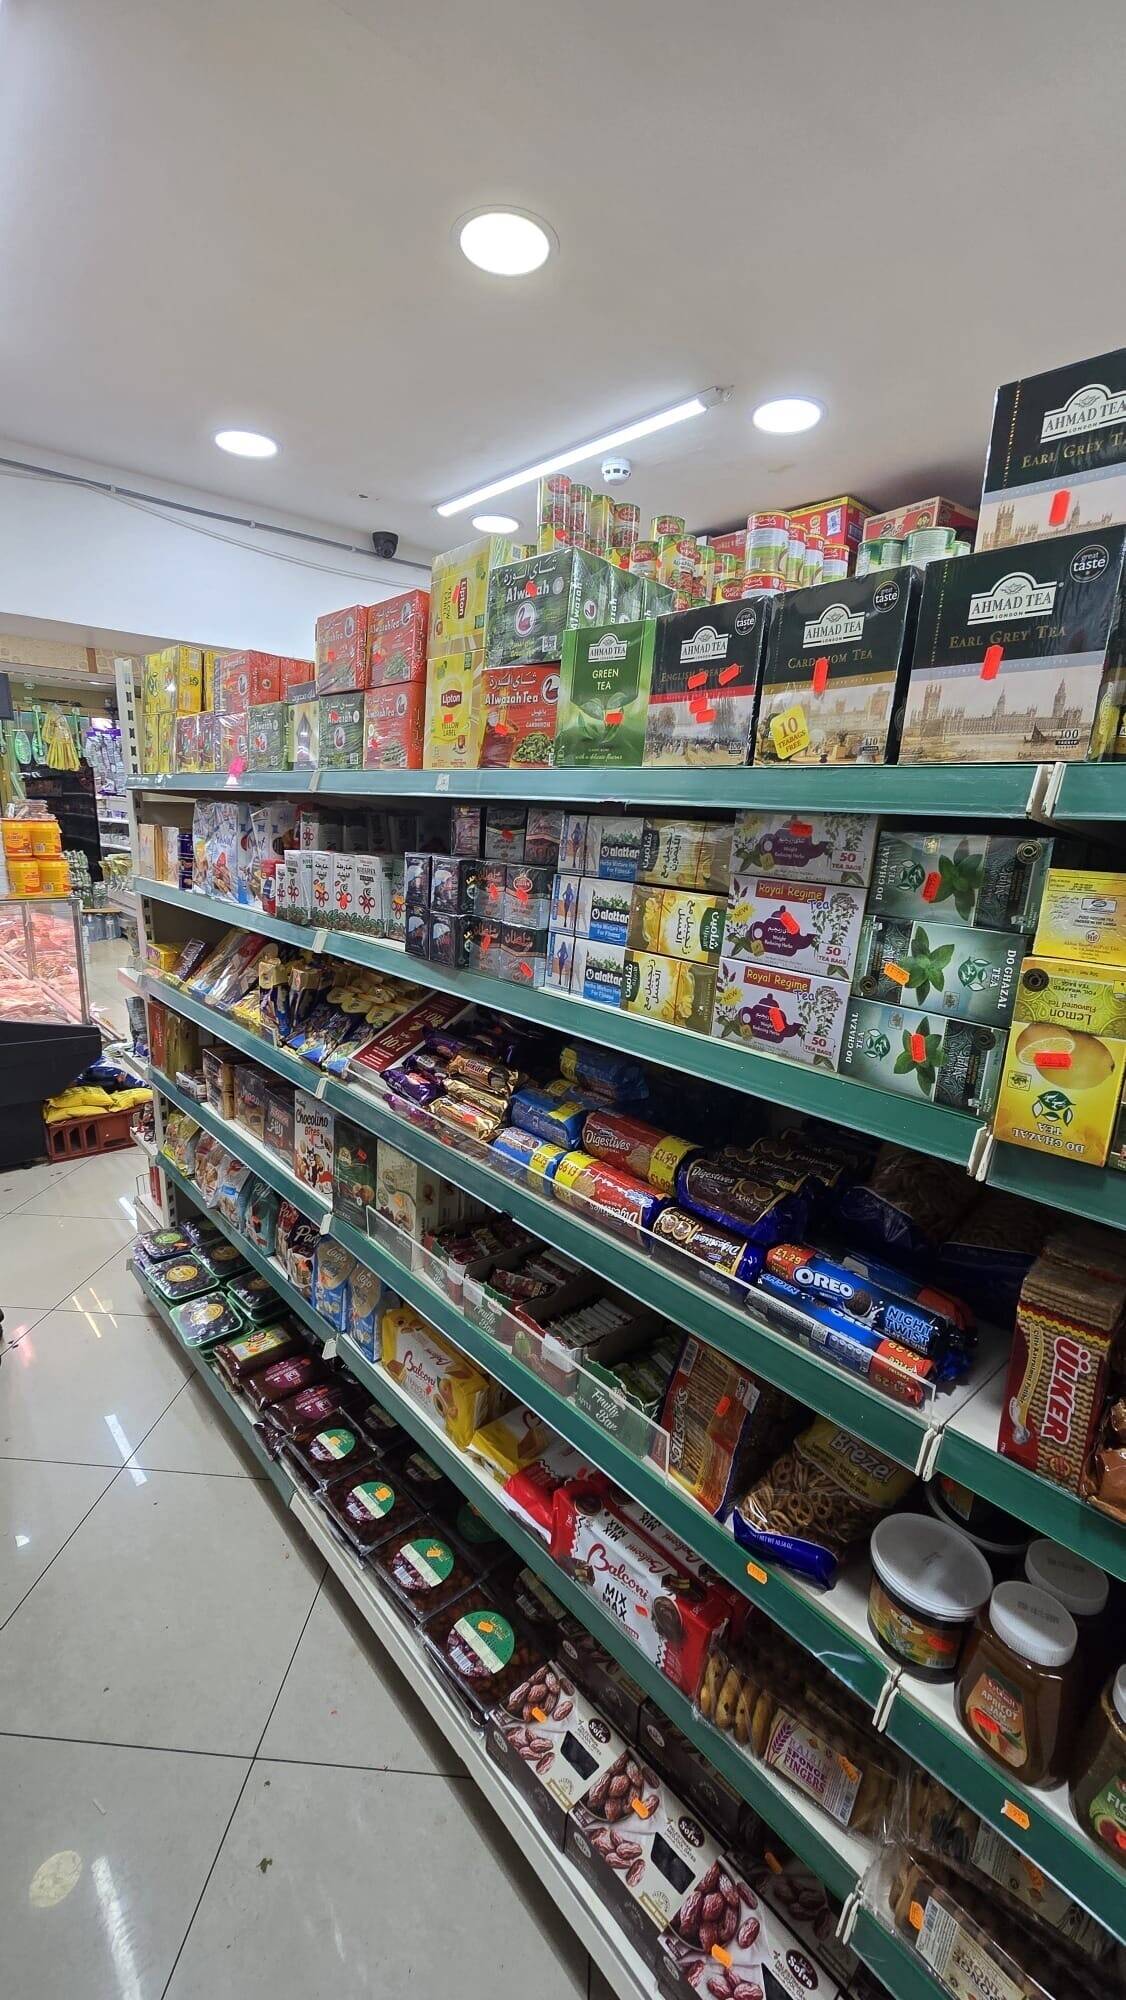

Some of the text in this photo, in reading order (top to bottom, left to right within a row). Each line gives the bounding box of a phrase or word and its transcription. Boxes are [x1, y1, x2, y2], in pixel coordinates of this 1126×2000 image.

[1044, 408, 1097, 432] AHMAD
[1068, 422, 1098, 433] LONDON
[1021, 440, 1104, 469] EARL GREY
[1072, 556, 1106, 573] taste
[458, 580, 466, 617] Lipton
[506, 580, 550, 602] Alwaah
[874, 592, 898, 604] taste
[972, 592, 1052, 616] AHMAD TEA
[994, 610, 1024, 620] LONDON
[805, 621, 862, 640] AHMAD TEA
[950, 624, 1067, 649] EARL GREY TEA
[589, 646, 626, 658] AHMAD TEA
[682, 638, 726, 656] AHMAD TEA
[788, 649, 873, 668] CARDOM TEA
[592, 668, 619, 678] GREEN
[597, 682, 612, 691] TEA
[442, 694, 462, 706] Lipton
[484, 691, 539, 706] Alwazah Tea
[779, 716, 798, 739] 10
[1059, 728, 1079, 740] 100
[778, 728, 806, 749] TEABAGS
[785, 741, 802, 753] FREE
[864, 737, 879, 747] 110
[840, 853, 856, 862] 50
[876, 845, 891, 900] DO GHAZAL
[887, 864, 897, 884] TEA
[760, 884, 822, 901] Royal Regime
[808, 899, 830, 910] Tea
[600, 910, 630, 924] alattar
[826, 946, 842, 956] 50
[830, 957, 847, 965] BAGS
[746, 969, 808, 991] Royal Regime
[990, 968, 1001, 988] TEA
[997, 950, 1017, 1010] DO GHAZAL
[724, 990, 738, 1000] NEW
[793, 989, 815, 1000] Tea
[1048, 1000, 1097, 1013] Flavoured Tea
[1048, 1008, 1092, 1026] Lemon
[811, 1036, 826, 1047] 50
[846, 1012, 859, 1064] DO GHAZAL
[856, 1030, 866, 1048] TEA
[805, 1044, 832, 1056] TEA BAGS
[296, 1108, 329, 1128] Chocolino
[304, 1126, 320, 1137] Bites
[1036, 1122, 1062, 1136] TEA
[586, 1131, 632, 1150] Digestives
[1012, 1128, 1086, 1154] DO GHAZAL
[653, 1150, 678, 1164] £1.99
[692, 1167, 736, 1184] Digestives
[694, 1232, 740, 1256] Digestives
[326, 1248, 346, 1264] Lago
[774, 1247, 802, 1264] £1.29
[357, 1271, 372, 1288] Lago
[795, 1266, 855, 1298] OREO
[478, 1318, 496, 1336] Bar
[887, 1305, 934, 1334] NIGHT
[884, 1317, 930, 1346] TWIST
[404, 1350, 436, 1386] Balconi
[1041, 1336, 1092, 1446] ÜLKER
[592, 1390, 620, 1418] Fruity
[596, 1408, 618, 1432] Bar
[829, 1430, 896, 1482] Brezel
[602, 1527, 624, 1542] MIX
[608, 1518, 628, 1538] MAX
[625, 1542, 668, 1574] Balconi
[587, 1543, 649, 1601] Balconi
[605, 1582, 628, 1608] MIX
[602, 1592, 627, 1622] MAX
[982, 1690, 1020, 1720] APRICOT
[588, 1722, 606, 1744] Sofra
[783, 1754, 826, 1794] FINGERS
[786, 1747, 826, 1784] SPONGE
[680, 1820, 700, 1846] Sofra
[788, 1954, 812, 1989] Sofra
